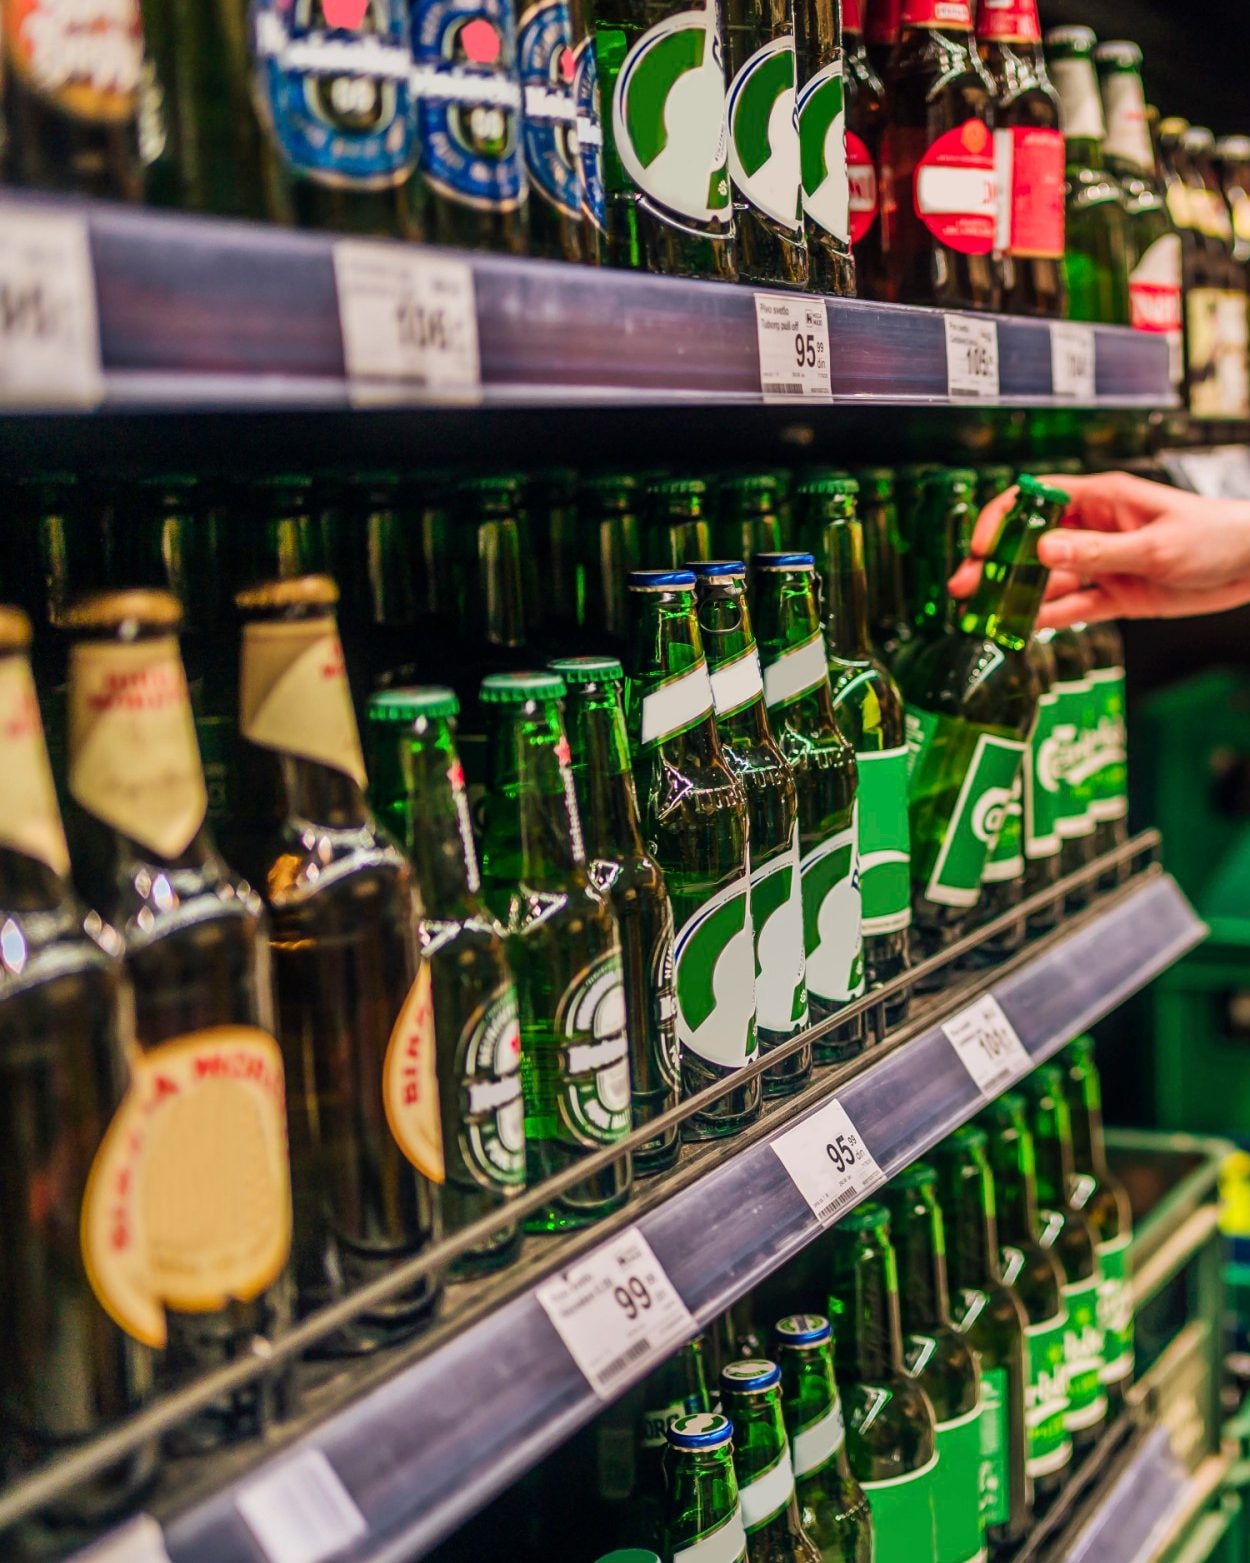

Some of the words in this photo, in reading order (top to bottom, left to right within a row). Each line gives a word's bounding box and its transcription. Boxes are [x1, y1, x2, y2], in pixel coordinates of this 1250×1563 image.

[795, 333, 816, 368] 95
[816, 342, 824, 353] 99
[817, 357, 826, 369] din
[826, 1134, 855, 1173] 95
[847, 1134, 857, 1147] 99
[855, 1149, 866, 1161] din
[614, 1276, 652, 1320] 99
